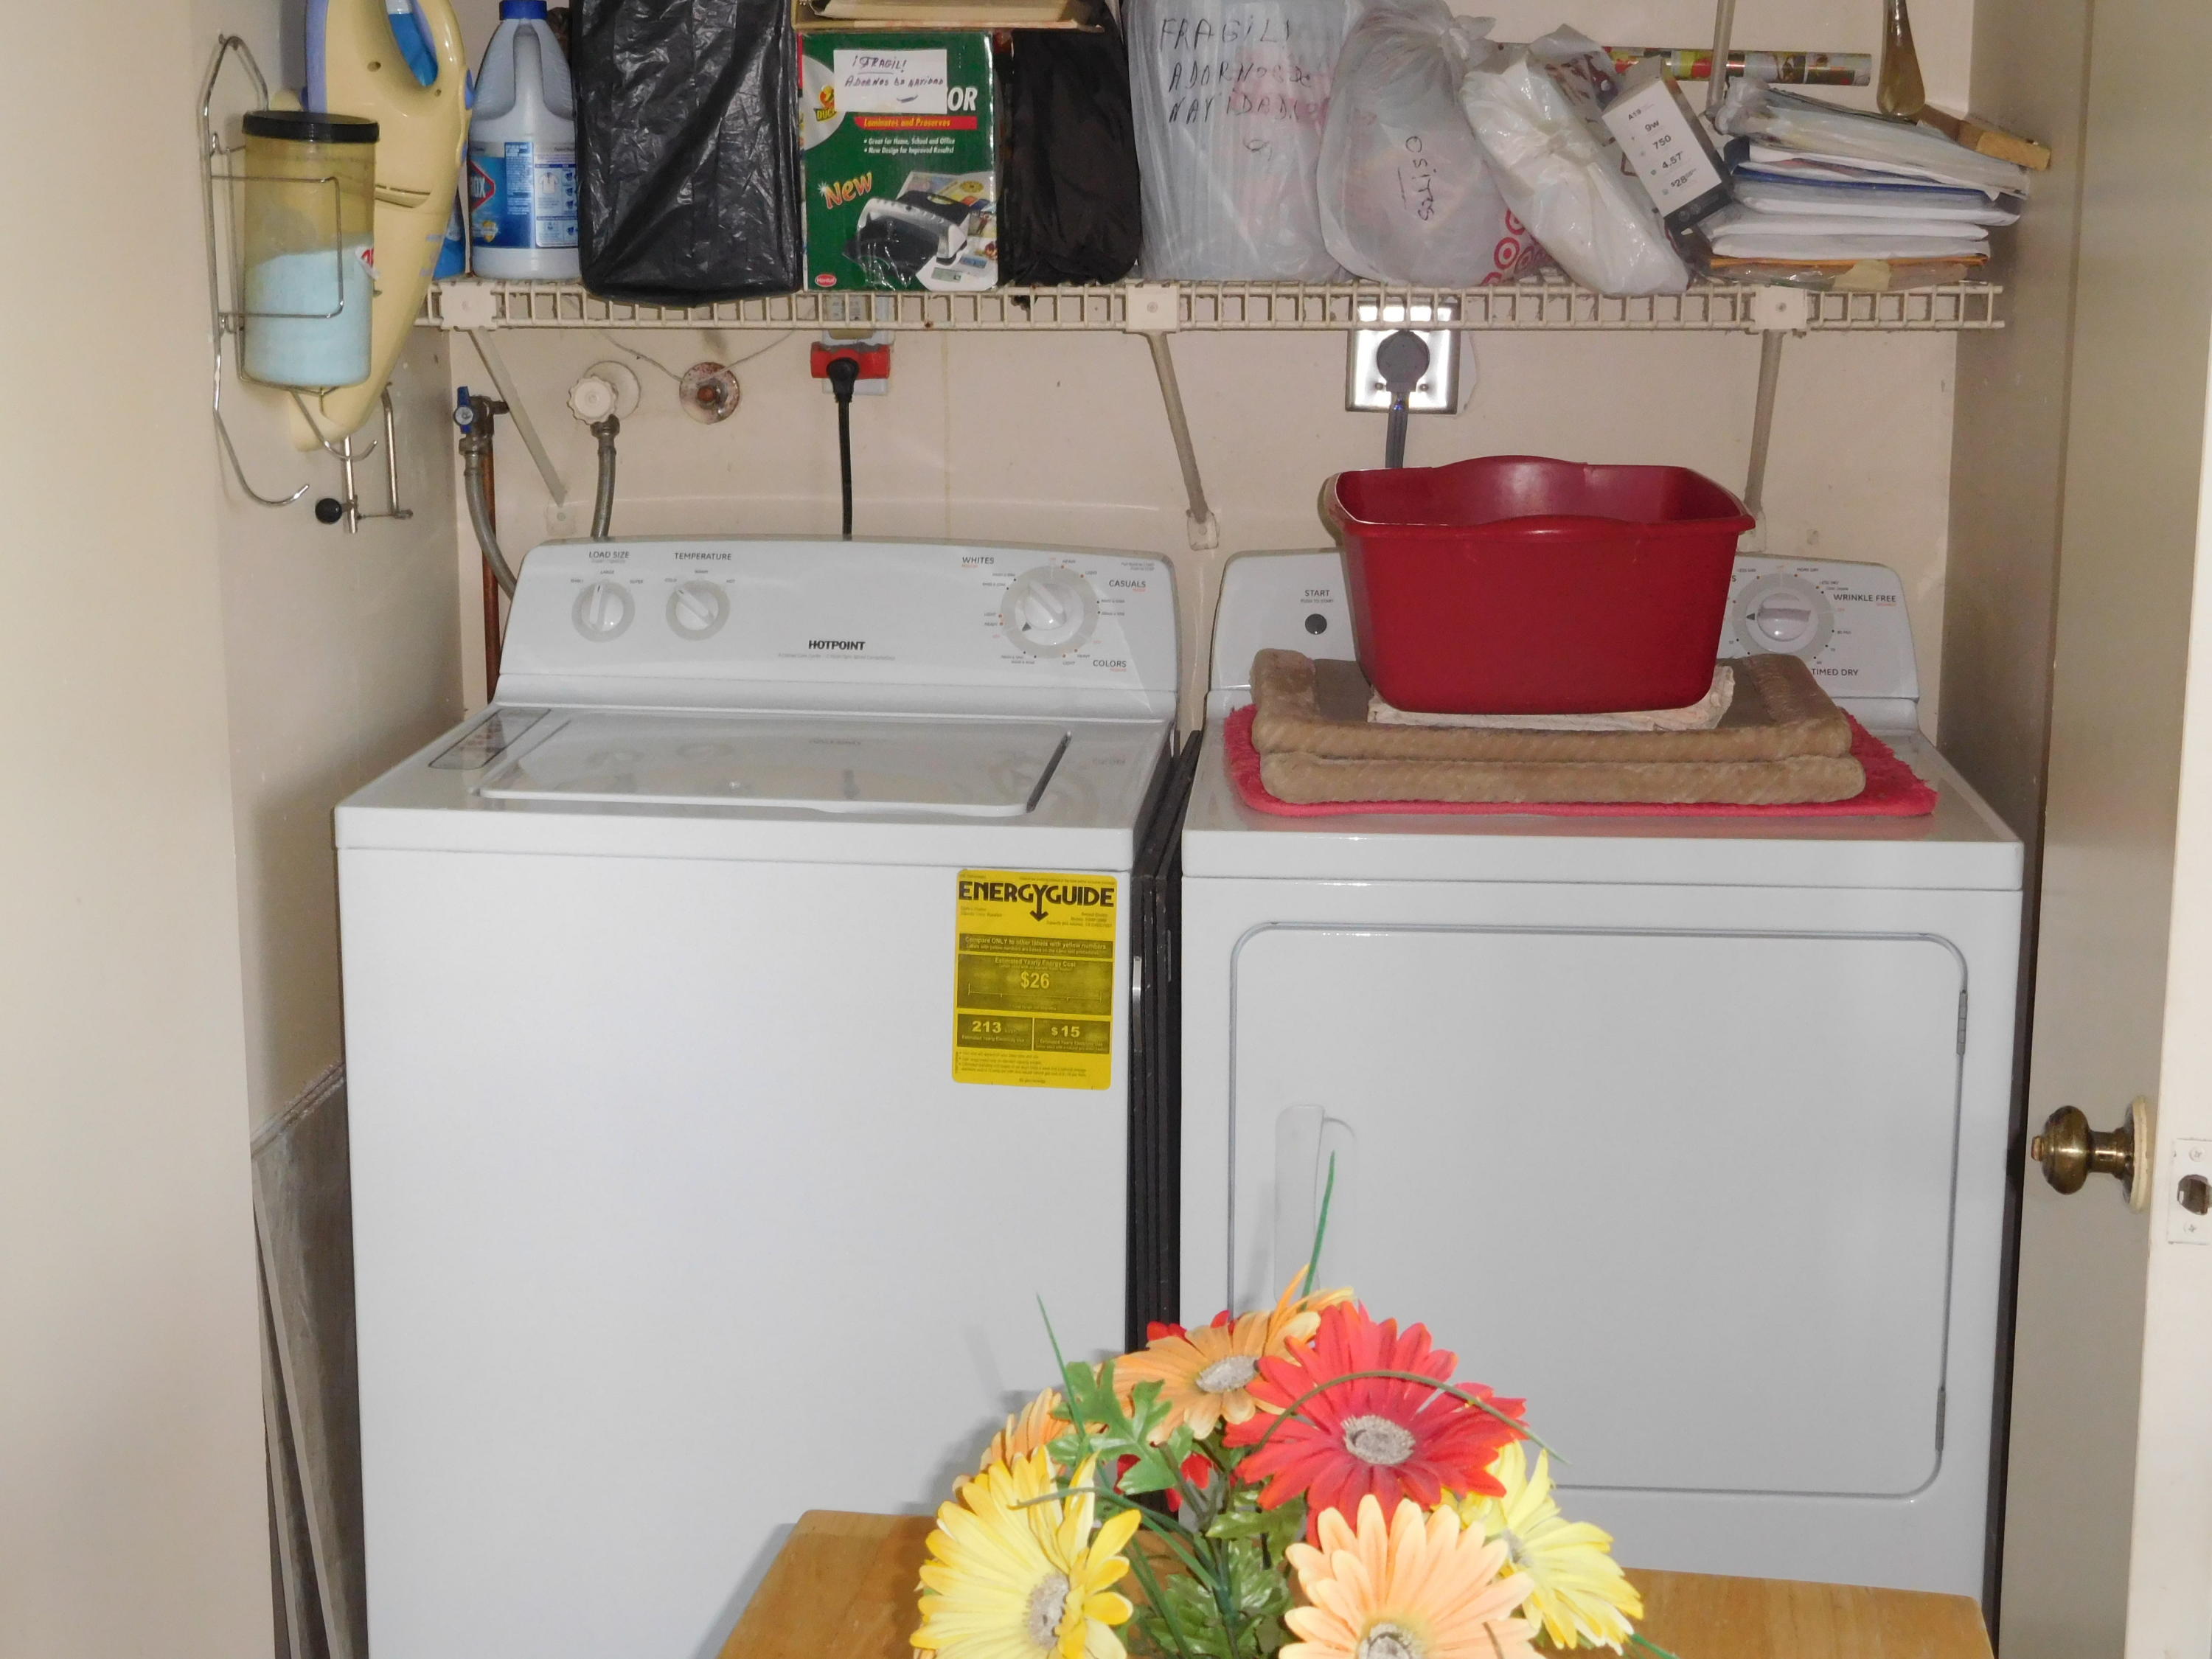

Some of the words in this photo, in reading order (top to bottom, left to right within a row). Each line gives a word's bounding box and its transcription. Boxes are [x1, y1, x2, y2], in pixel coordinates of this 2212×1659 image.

[901, 119, 914, 127] and
[915, 118, 950, 127] Preserves
[1652, 135, 1672, 150] 750
[1662, 152, 1683, 170] 4.57
[1109, 580, 1147, 588] CASUALS
[808, 640, 866, 650] HOTPOINT
[1093, 660, 1127, 668] COLORS
[1812, 668, 1839, 676] TIMED
[959, 880, 1114, 908] ENERGYGUIDE
[1020, 972, 1050, 990] $26
[972, 1020, 1001, 1033] 213
